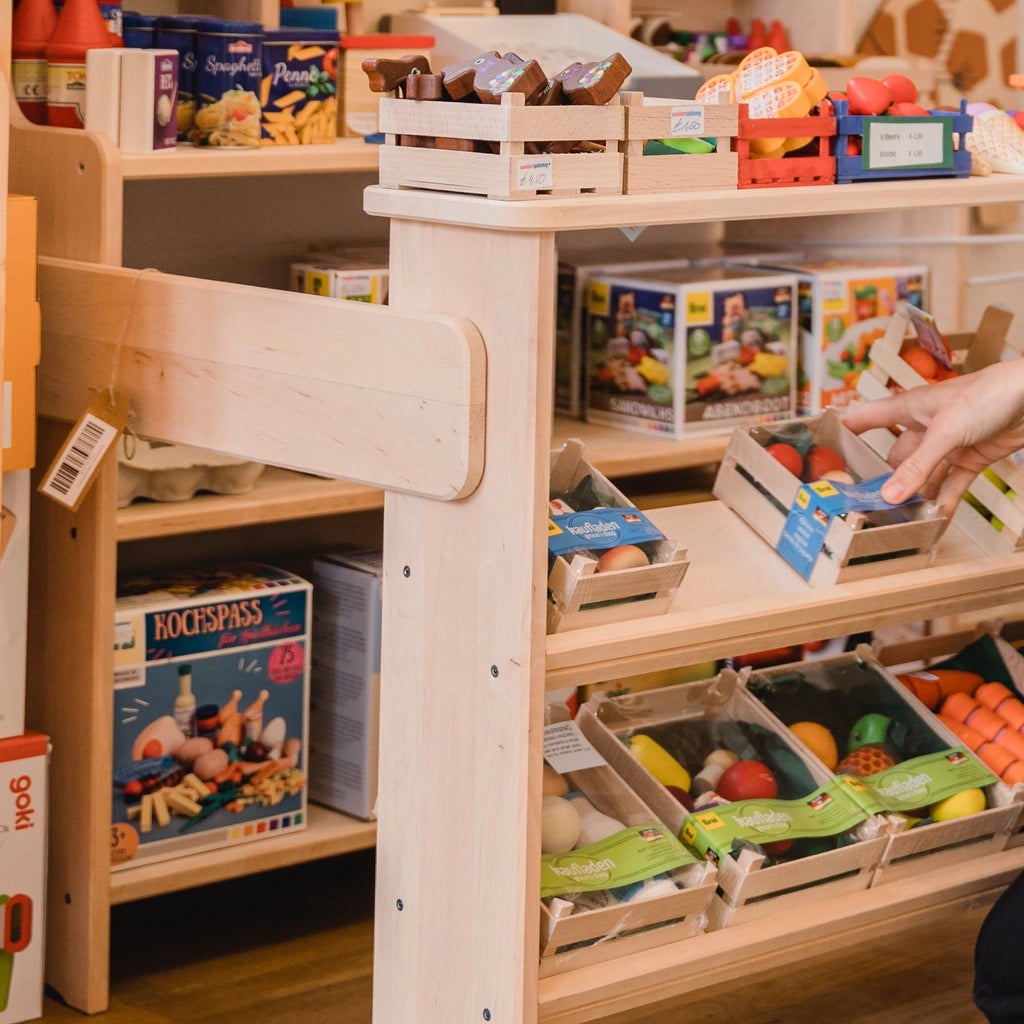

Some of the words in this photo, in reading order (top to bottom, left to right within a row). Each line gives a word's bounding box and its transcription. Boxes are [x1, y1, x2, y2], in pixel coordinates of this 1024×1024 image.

[272, 61, 319, 86] Penne
[565, 520, 620, 536] kaufladen
[154, 599, 264, 641] KOCHSPASS
[278, 643, 295, 665] 75
[9, 774, 35, 831] goki
[547, 858, 616, 876] kaufladen
